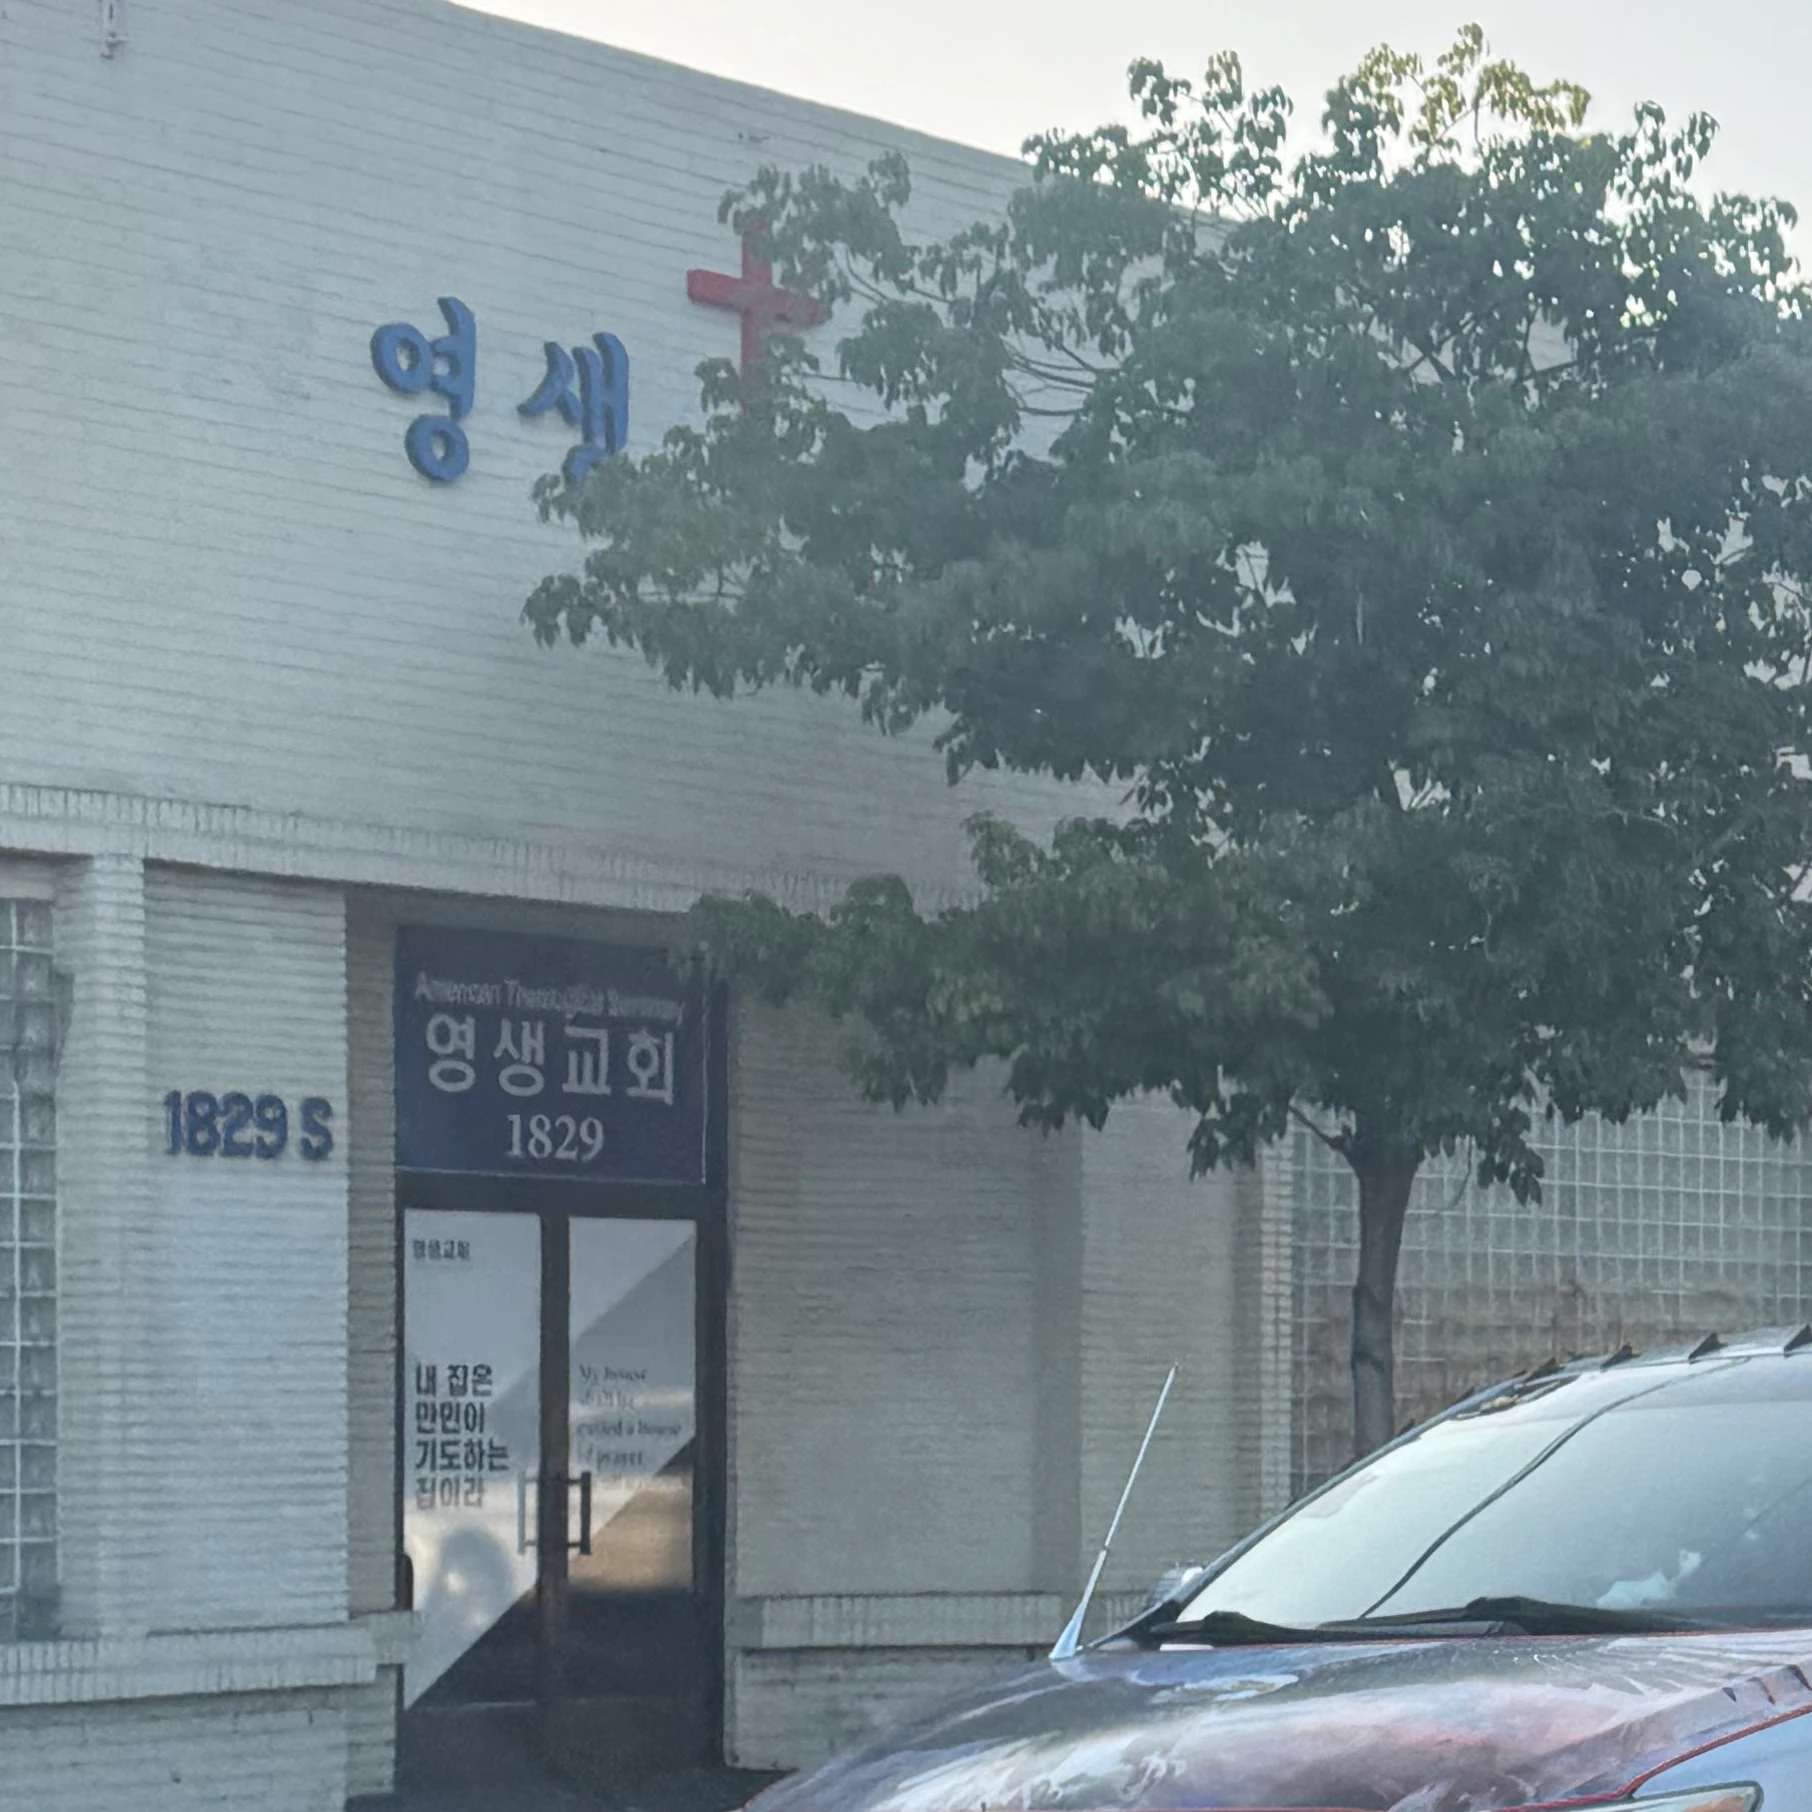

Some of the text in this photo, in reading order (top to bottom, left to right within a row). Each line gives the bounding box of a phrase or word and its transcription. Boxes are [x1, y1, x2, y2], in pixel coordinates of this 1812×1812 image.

[426, 1013, 674, 1105] 영생교회
[165, 1089, 333, 1161] 1829 S
[507, 1114, 604, 1162] 1829
[416, 1363, 493, 1397] 내 집은
[416, 1402, 485, 1434] 만민이
[416, 1438, 509, 1472] 기도하는
[416, 1477, 485, 1510] 집이라
